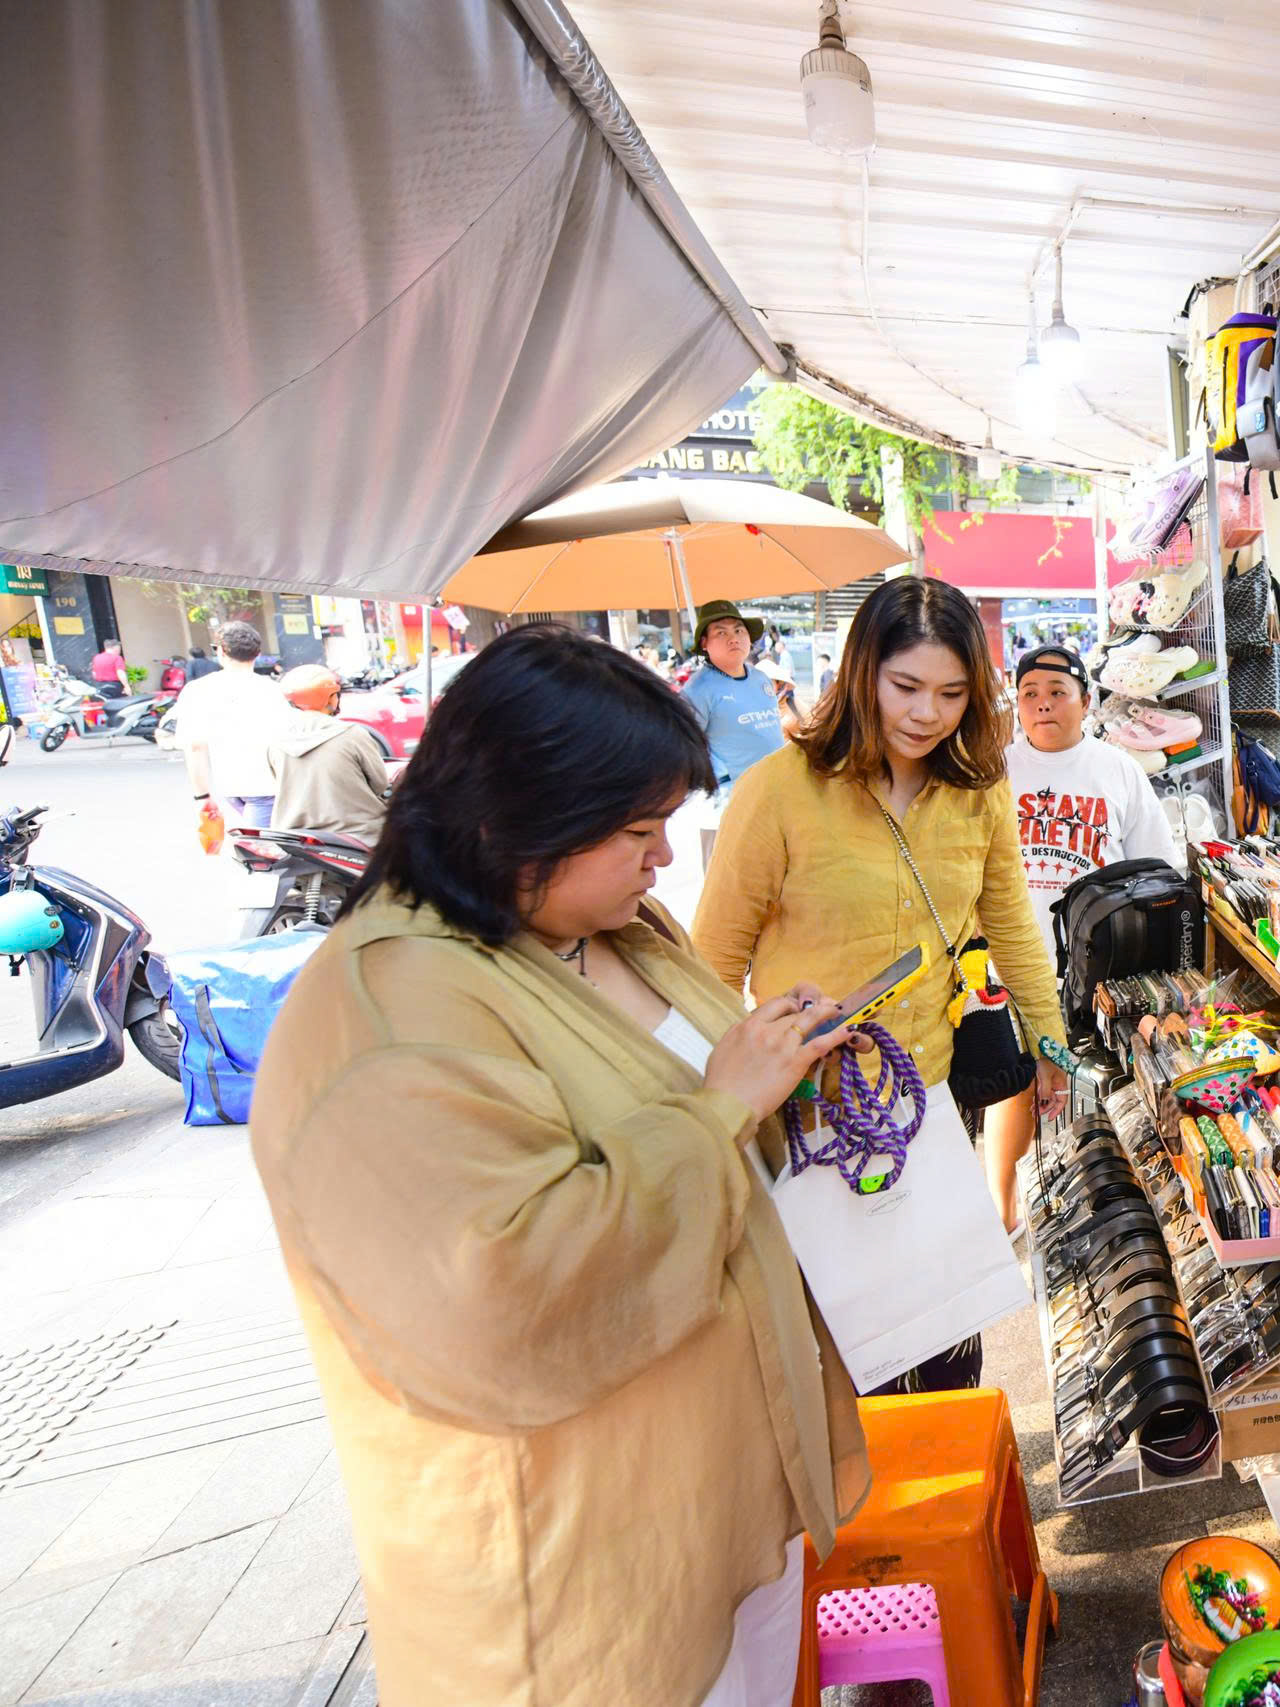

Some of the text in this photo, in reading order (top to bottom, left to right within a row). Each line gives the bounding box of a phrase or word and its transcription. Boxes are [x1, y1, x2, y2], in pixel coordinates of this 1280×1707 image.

[1155, 502, 1180, 530] crocs
[55, 596, 77, 608] 190
[1031, 847, 1092, 871] DESTRUCTION
